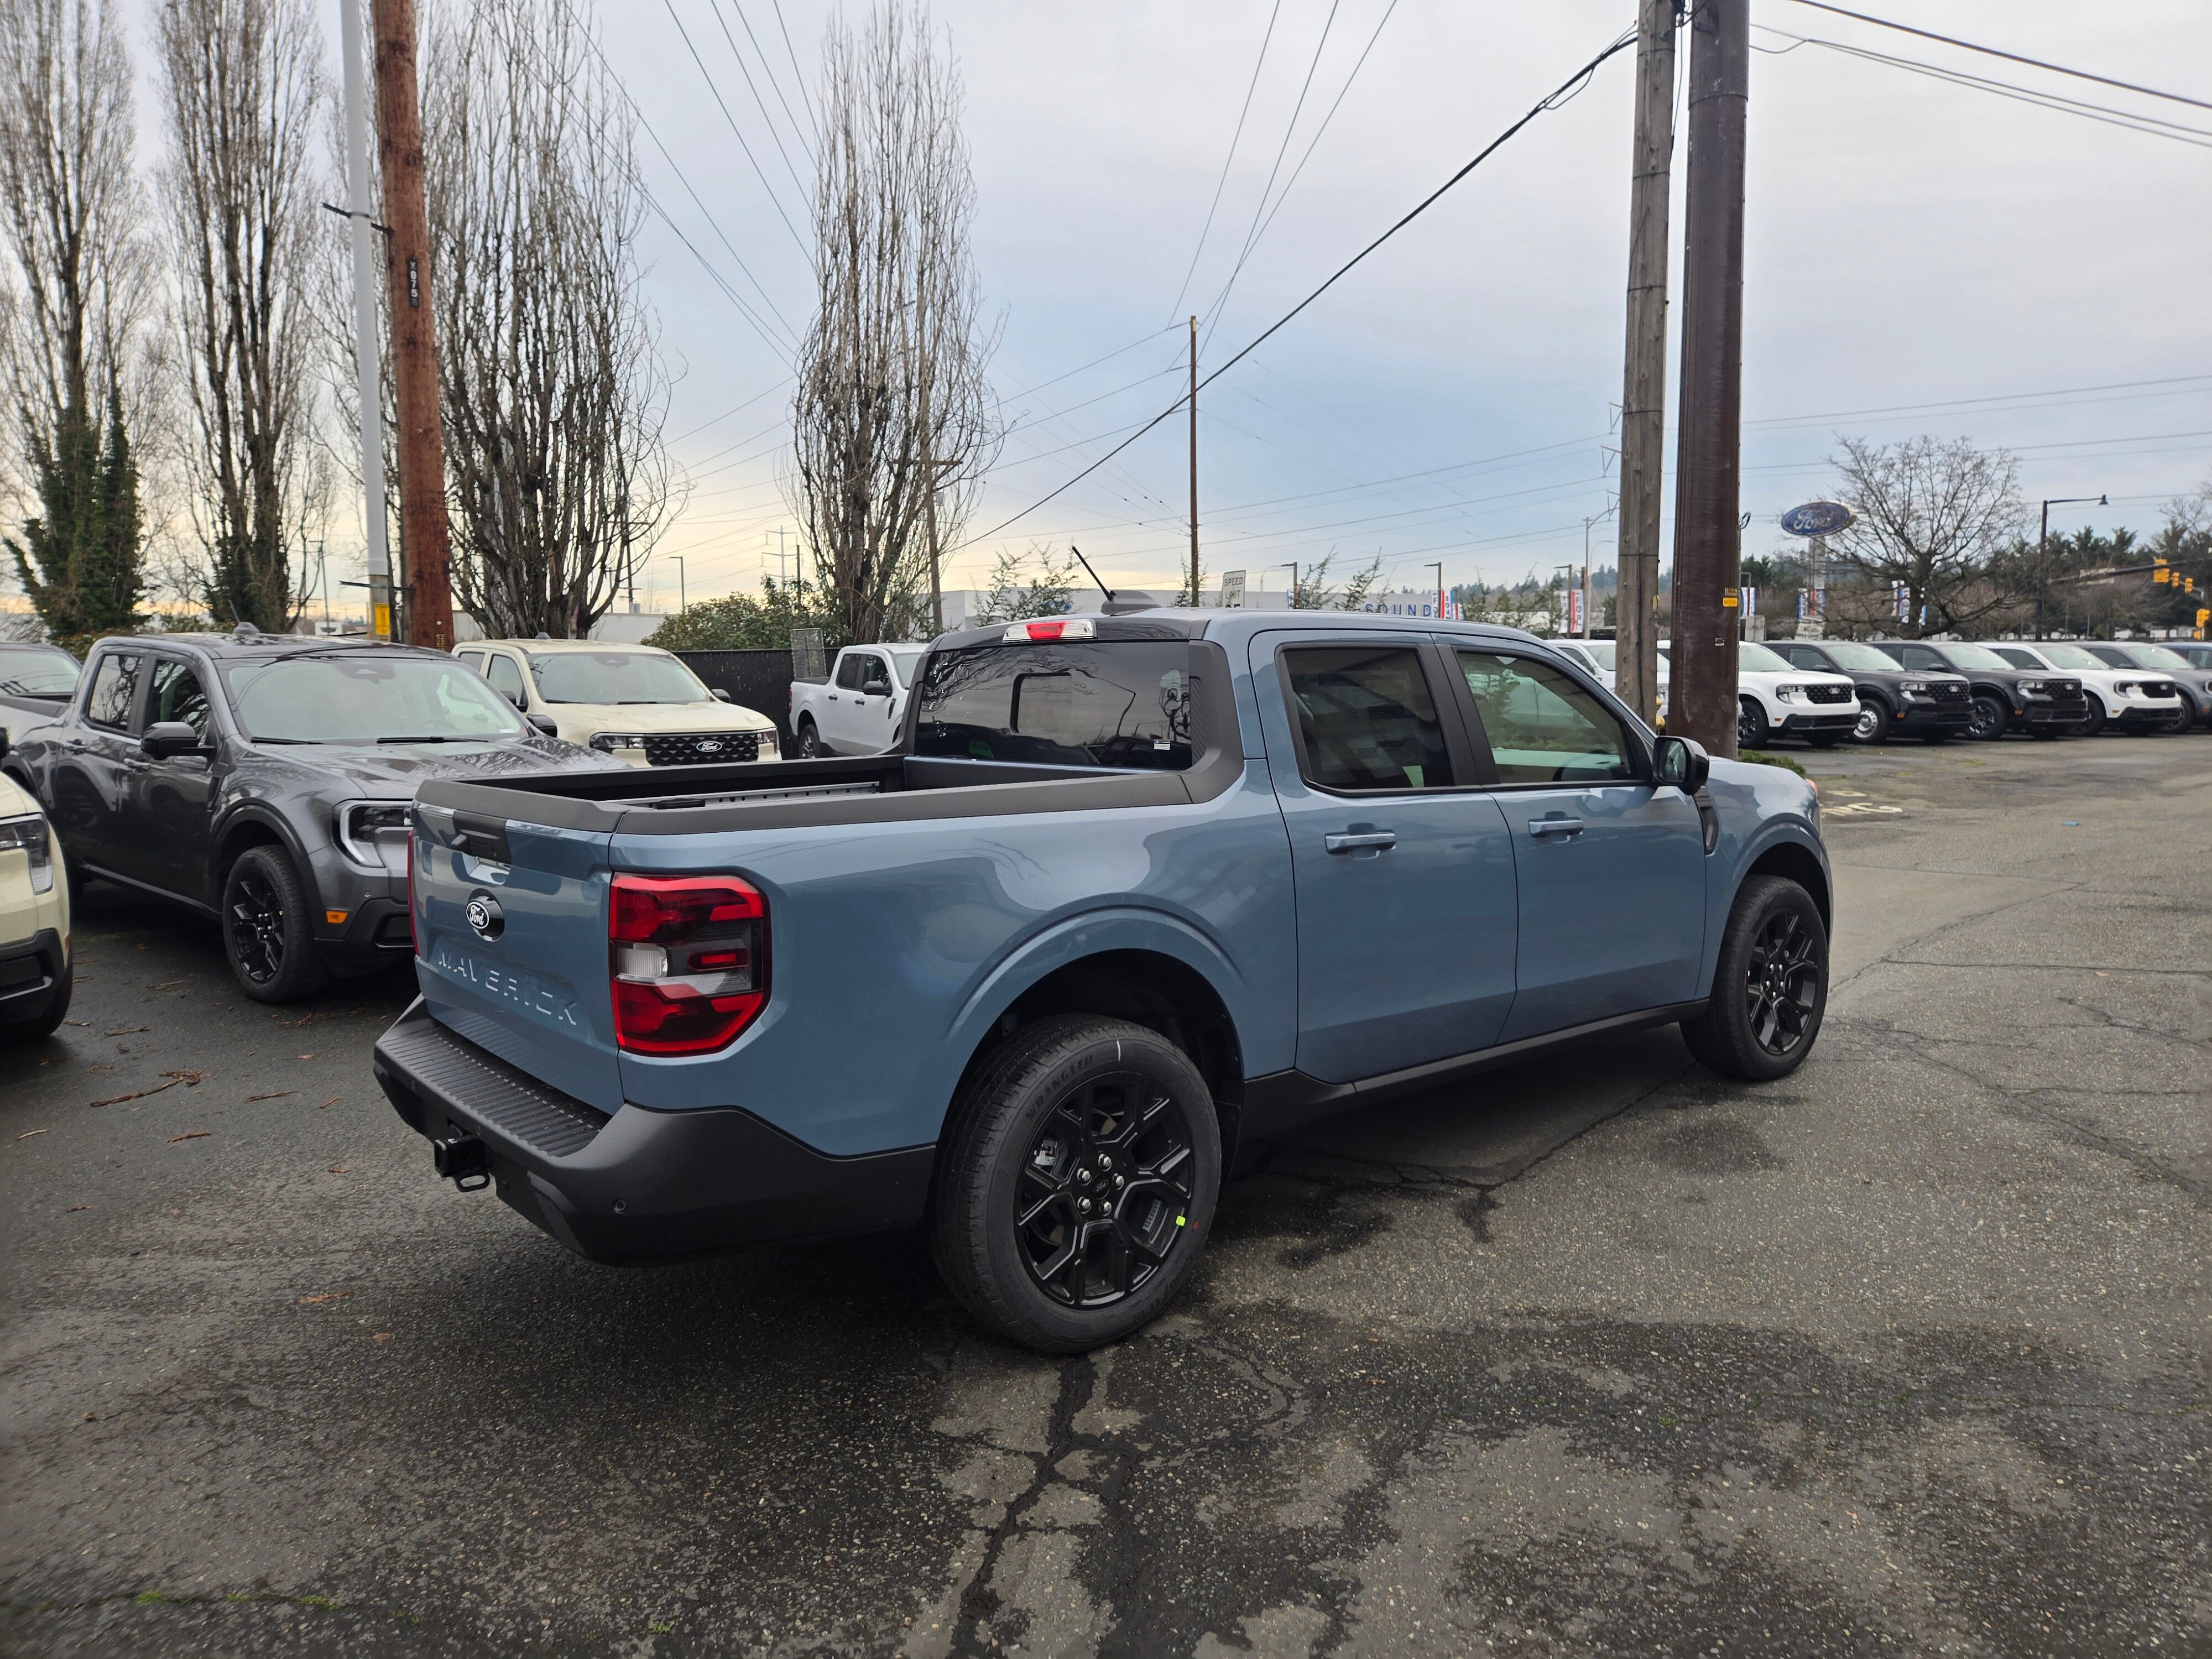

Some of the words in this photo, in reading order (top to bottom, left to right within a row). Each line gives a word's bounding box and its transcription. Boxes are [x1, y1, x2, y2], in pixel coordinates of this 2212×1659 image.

[1224, 577, 1243, 587] SPEED
[1225, 589, 1240, 599] LIMIT
[1365, 603, 1432, 617] SOUND
[469, 904, 484, 926] Ford
[1024, 1054, 1093, 1119] WRANGLER
